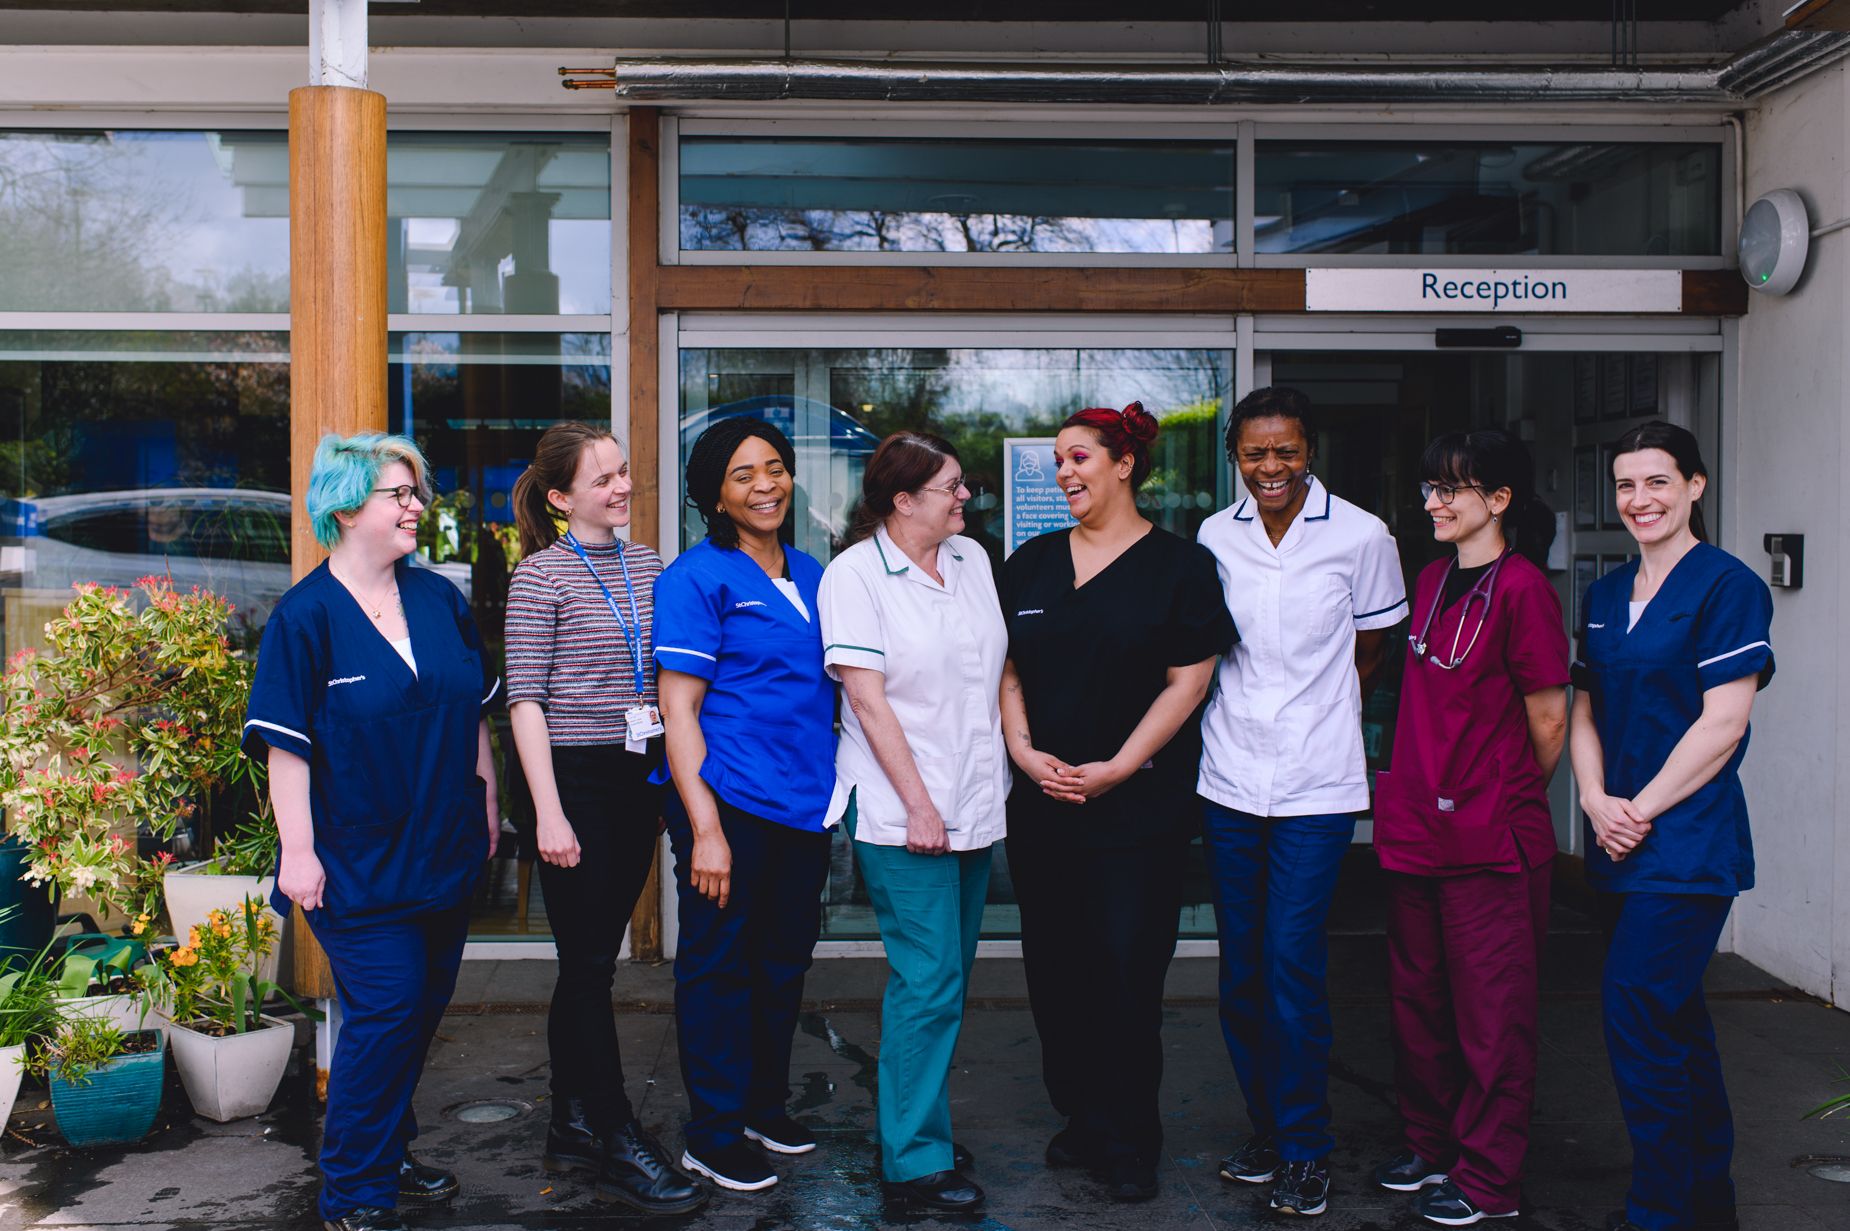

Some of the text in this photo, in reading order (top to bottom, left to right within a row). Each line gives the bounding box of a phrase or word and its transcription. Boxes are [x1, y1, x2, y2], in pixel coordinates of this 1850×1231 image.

[1422, 272, 1567, 308] Reception
[1016, 503, 1054, 511] volunteers
[1039, 512, 1068, 522] covering
[1016, 520, 1042, 529] visiting
